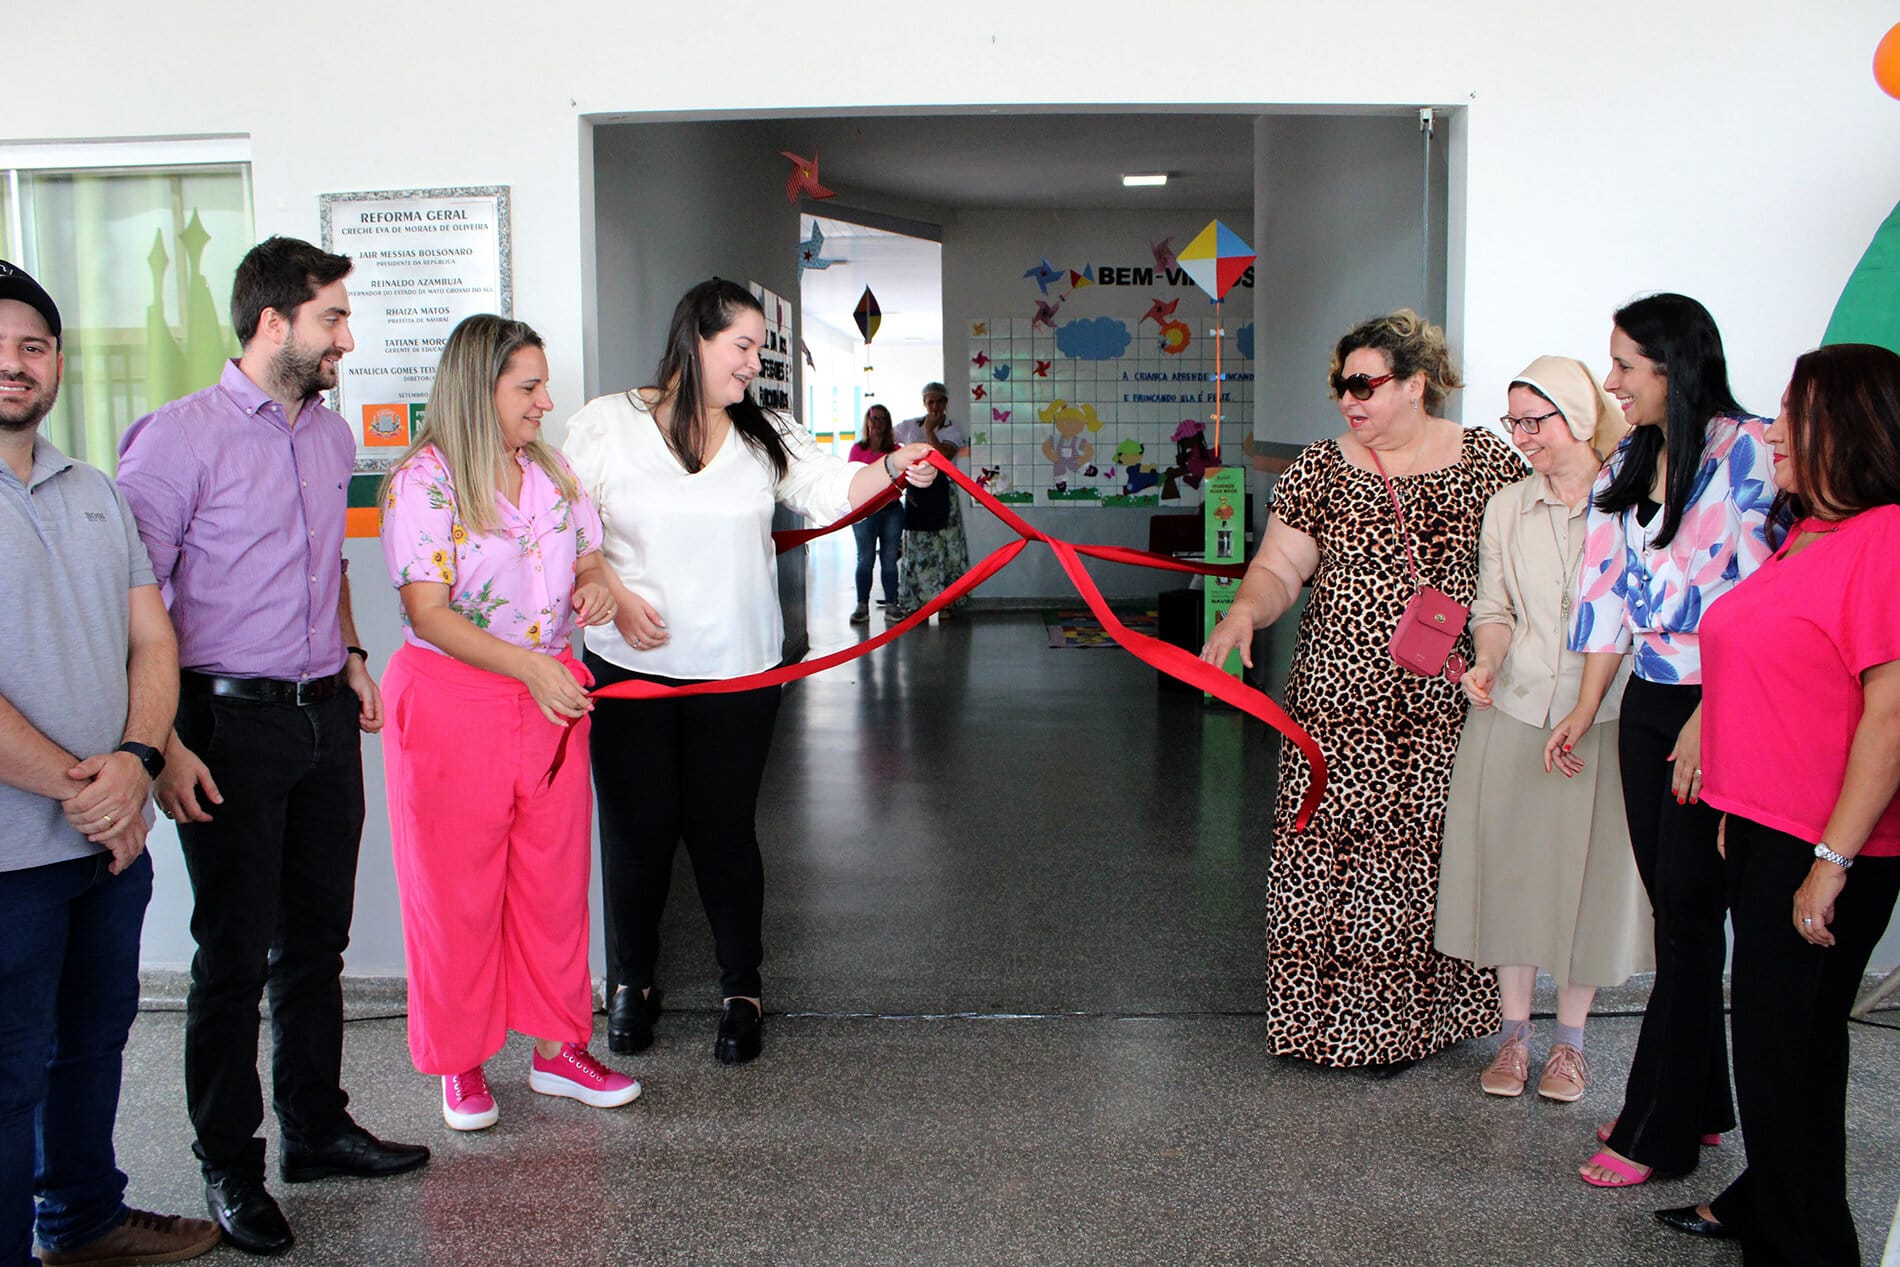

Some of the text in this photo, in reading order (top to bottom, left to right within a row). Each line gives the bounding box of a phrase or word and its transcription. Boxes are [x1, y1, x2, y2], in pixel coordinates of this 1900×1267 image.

[360, 209, 468, 223] REFORMA GERAL
[341, 227, 373, 235] CRECHE
[375, 226, 390, 234] EVA
[392, 226, 402, 234] DE
[404, 225, 437, 233] MORAES
[453, 223, 489, 231] OLIVEIRA
[359, 248, 473, 259] JAIR MESSIAS BOLSONARO
[1099, 266, 1254, 288] BEM-VIS
[371, 278, 463, 288] REINALDO AZAMBUJA
[385, 307, 450, 316] RHAIZA MATOS
[384, 338, 418, 347] TATIANE
[349, 367, 389, 376] NATALICIA
[390, 367, 418, 375] GOMES
[1122, 371, 1129, 381] A
[1134, 371, 1168, 382] CRIANÇA
[1171, 371, 1208, 381] APRENDE
[1123, 394, 1129, 402] E
[1181, 393, 1196, 402] ELA
[1198, 390, 1204, 402] É
